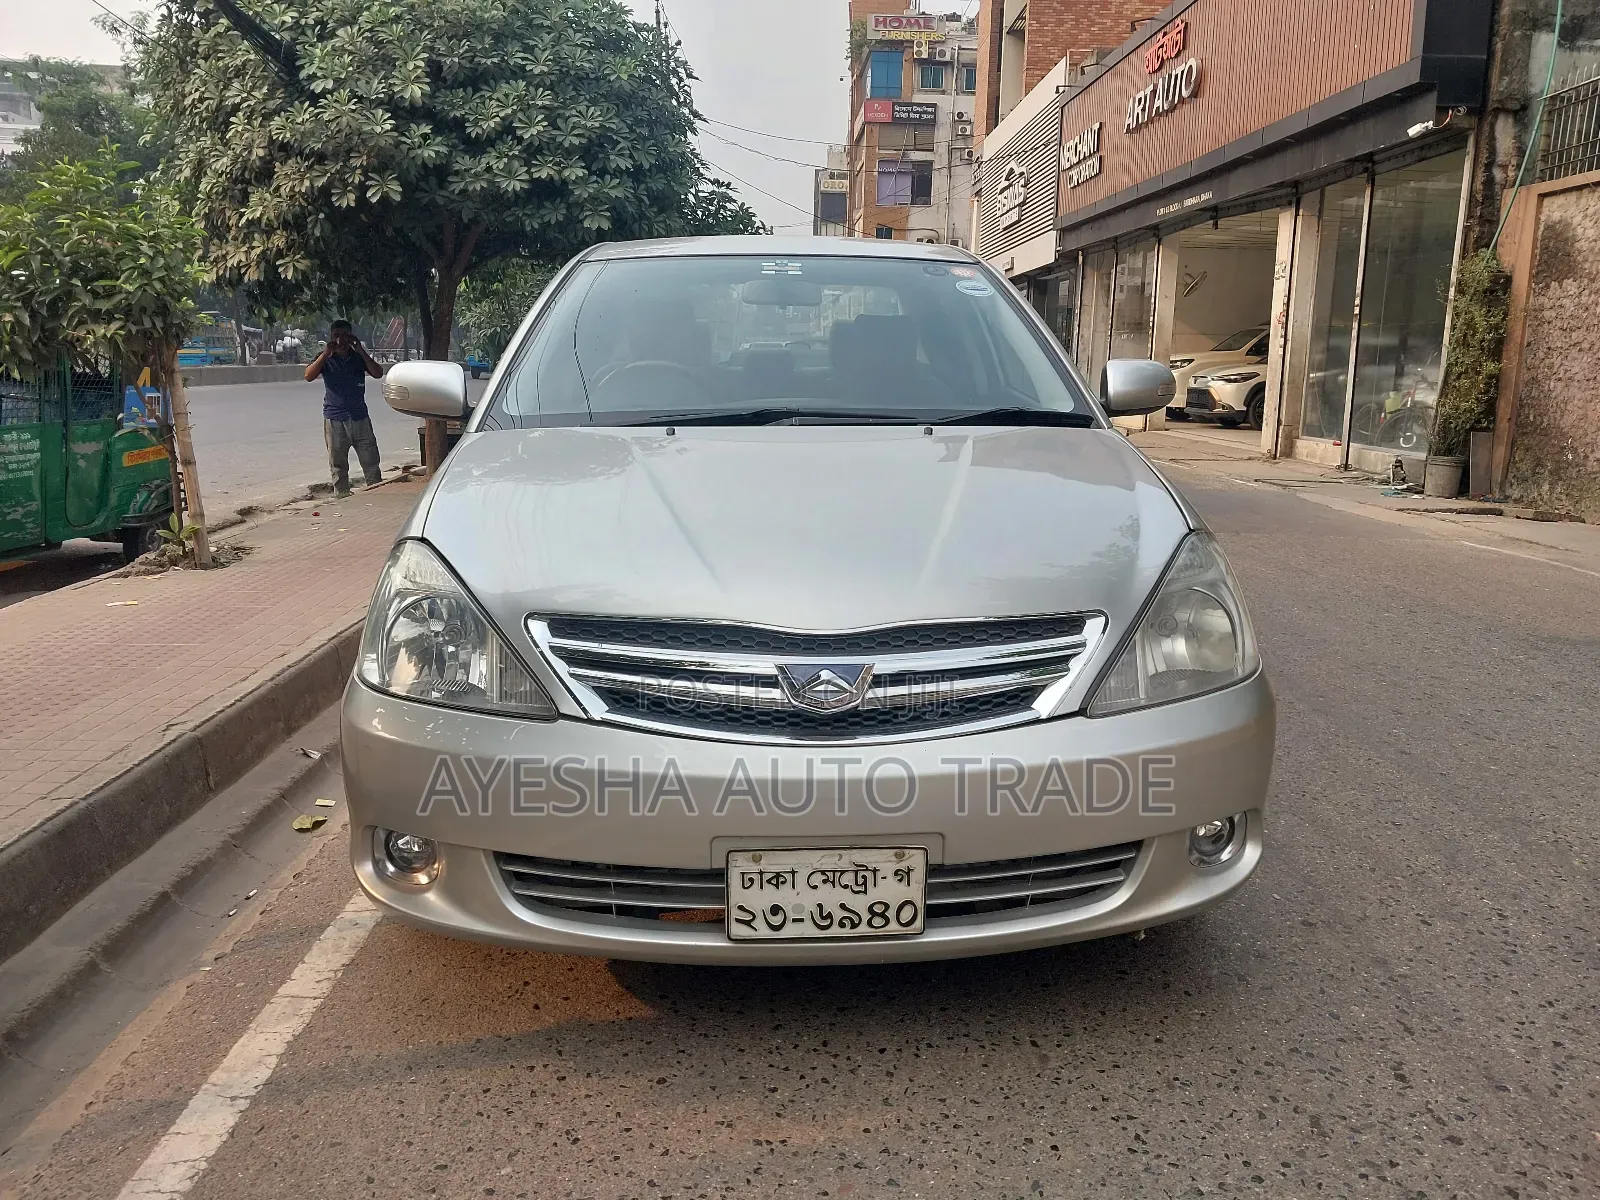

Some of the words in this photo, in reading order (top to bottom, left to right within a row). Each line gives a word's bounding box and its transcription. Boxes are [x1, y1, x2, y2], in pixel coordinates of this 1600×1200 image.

[873, 16, 935, 31] HOME
[880, 30, 946, 41] FURNISHERS
[1123, 83, 1154, 135] ART
[1151, 57, 1198, 118] AUTO
[1060, 121, 1101, 172] MERCHANT
[1068, 154, 1100, 189] CORPORATION
[739, 867, 799, 890] ঢাকা
[734, 899, 919, 932] ২৩-৬৯৪০
